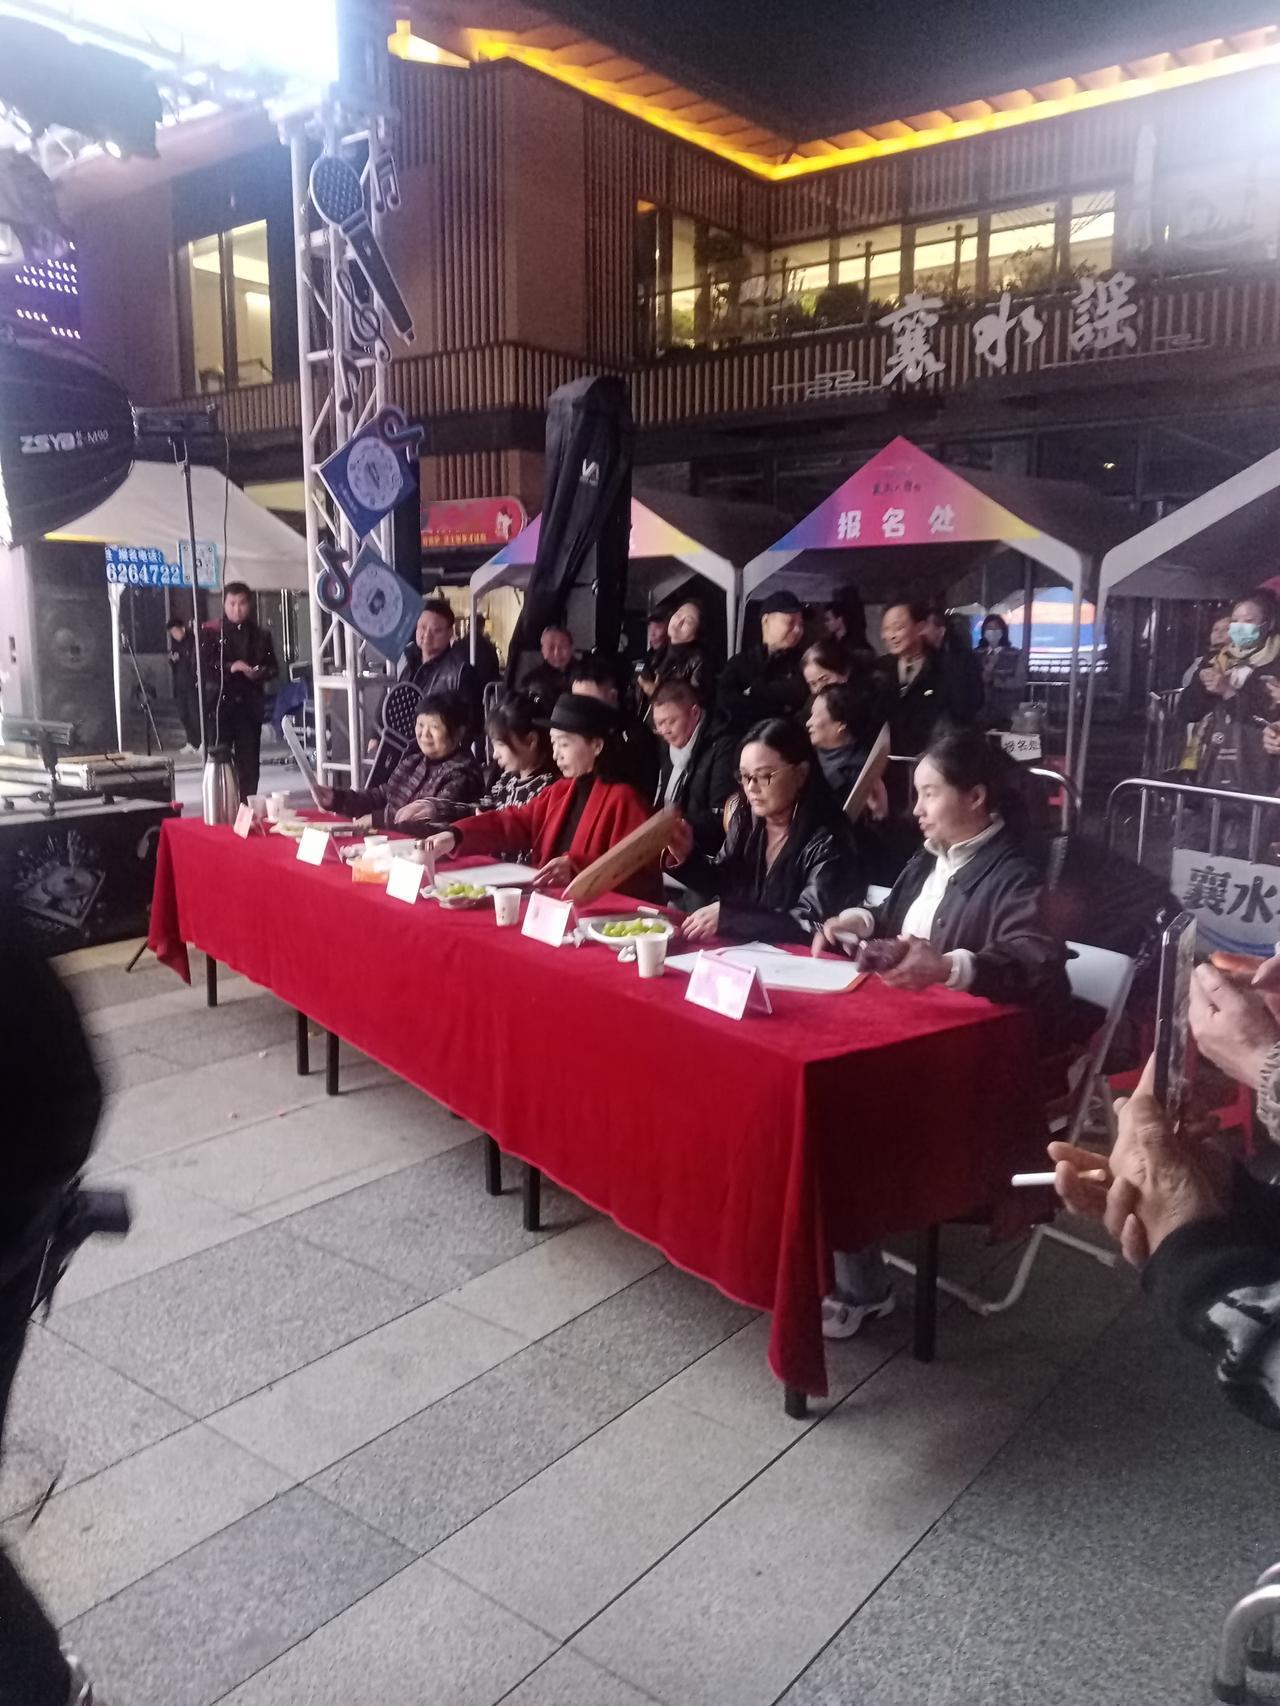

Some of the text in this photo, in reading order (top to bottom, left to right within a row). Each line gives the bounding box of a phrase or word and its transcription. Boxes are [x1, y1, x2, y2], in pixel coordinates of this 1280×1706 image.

[837, 504, 955, 541] 报名处
[105, 562, 181, 585] 6264722
[1182, 865, 1280, 924] 襄水
